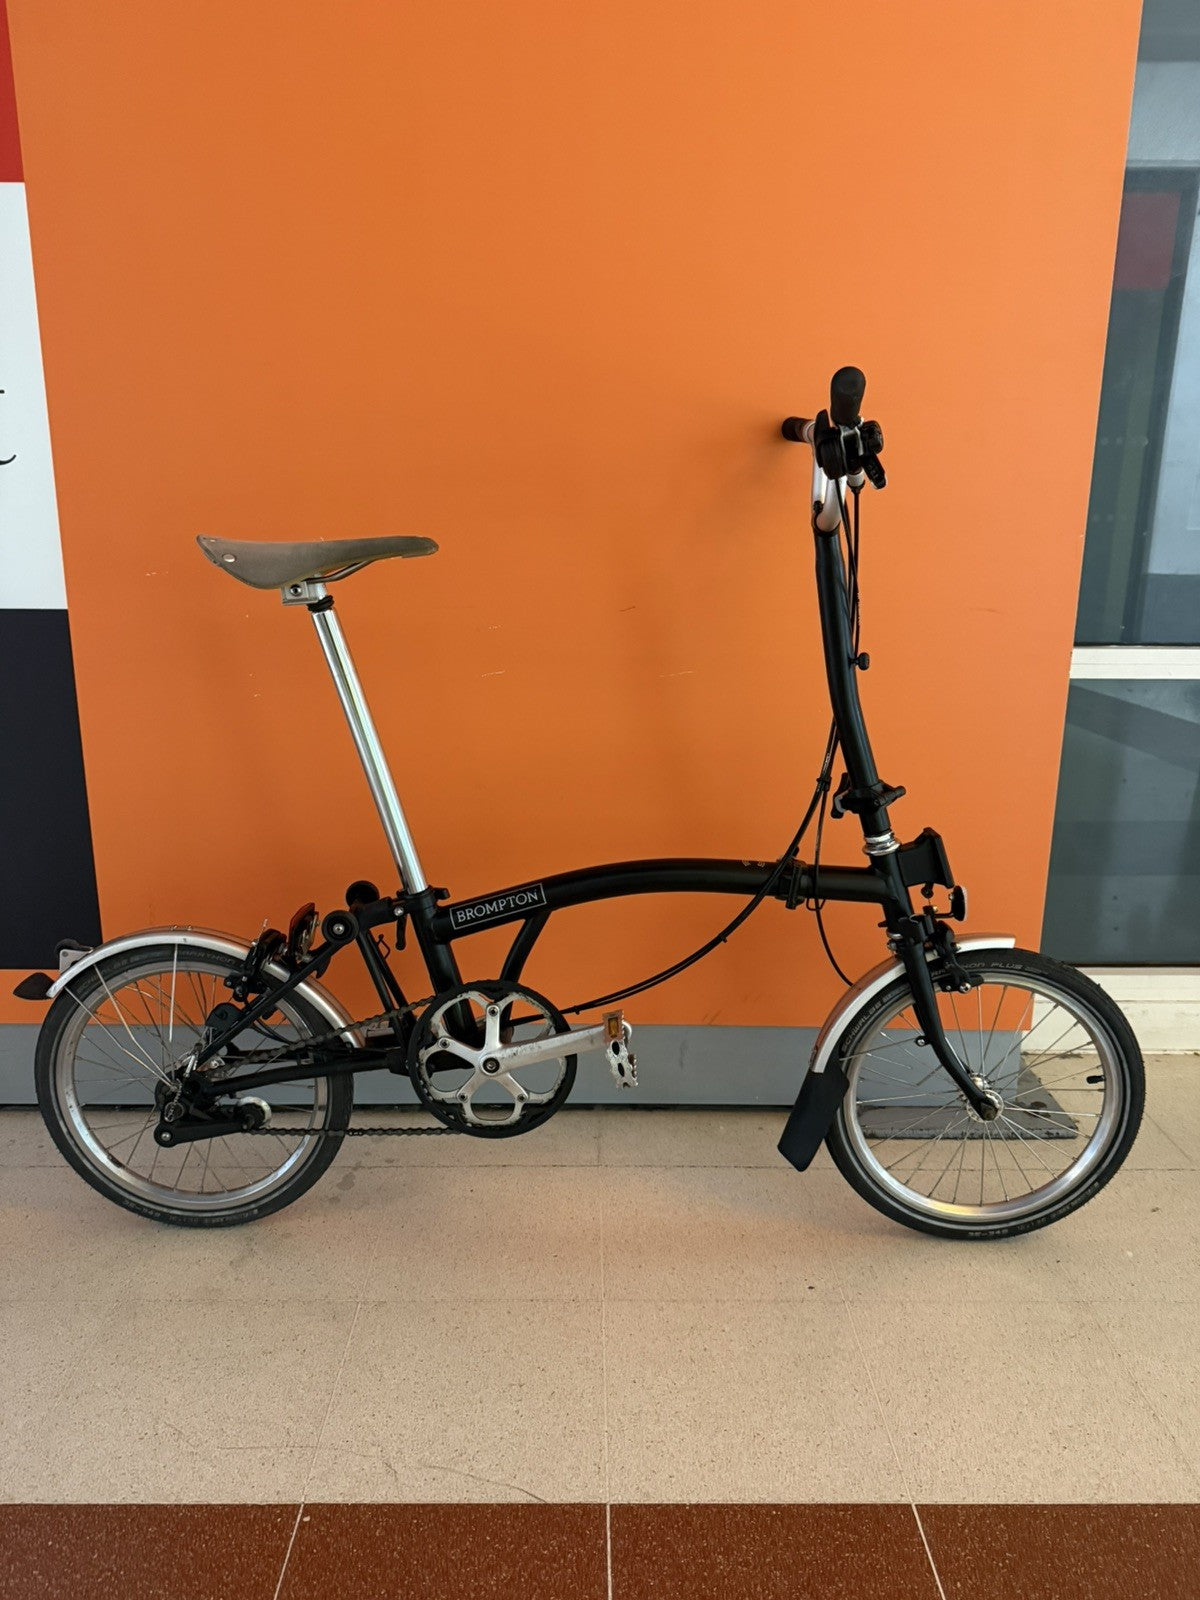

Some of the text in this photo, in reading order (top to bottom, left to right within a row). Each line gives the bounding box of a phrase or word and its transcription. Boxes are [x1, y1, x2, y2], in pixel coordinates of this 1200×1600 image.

[456, 889, 539, 923] BROMPTON
[991, 962, 1023, 970] PLUS
[841, 1000, 882, 1053] SCHWALBE
